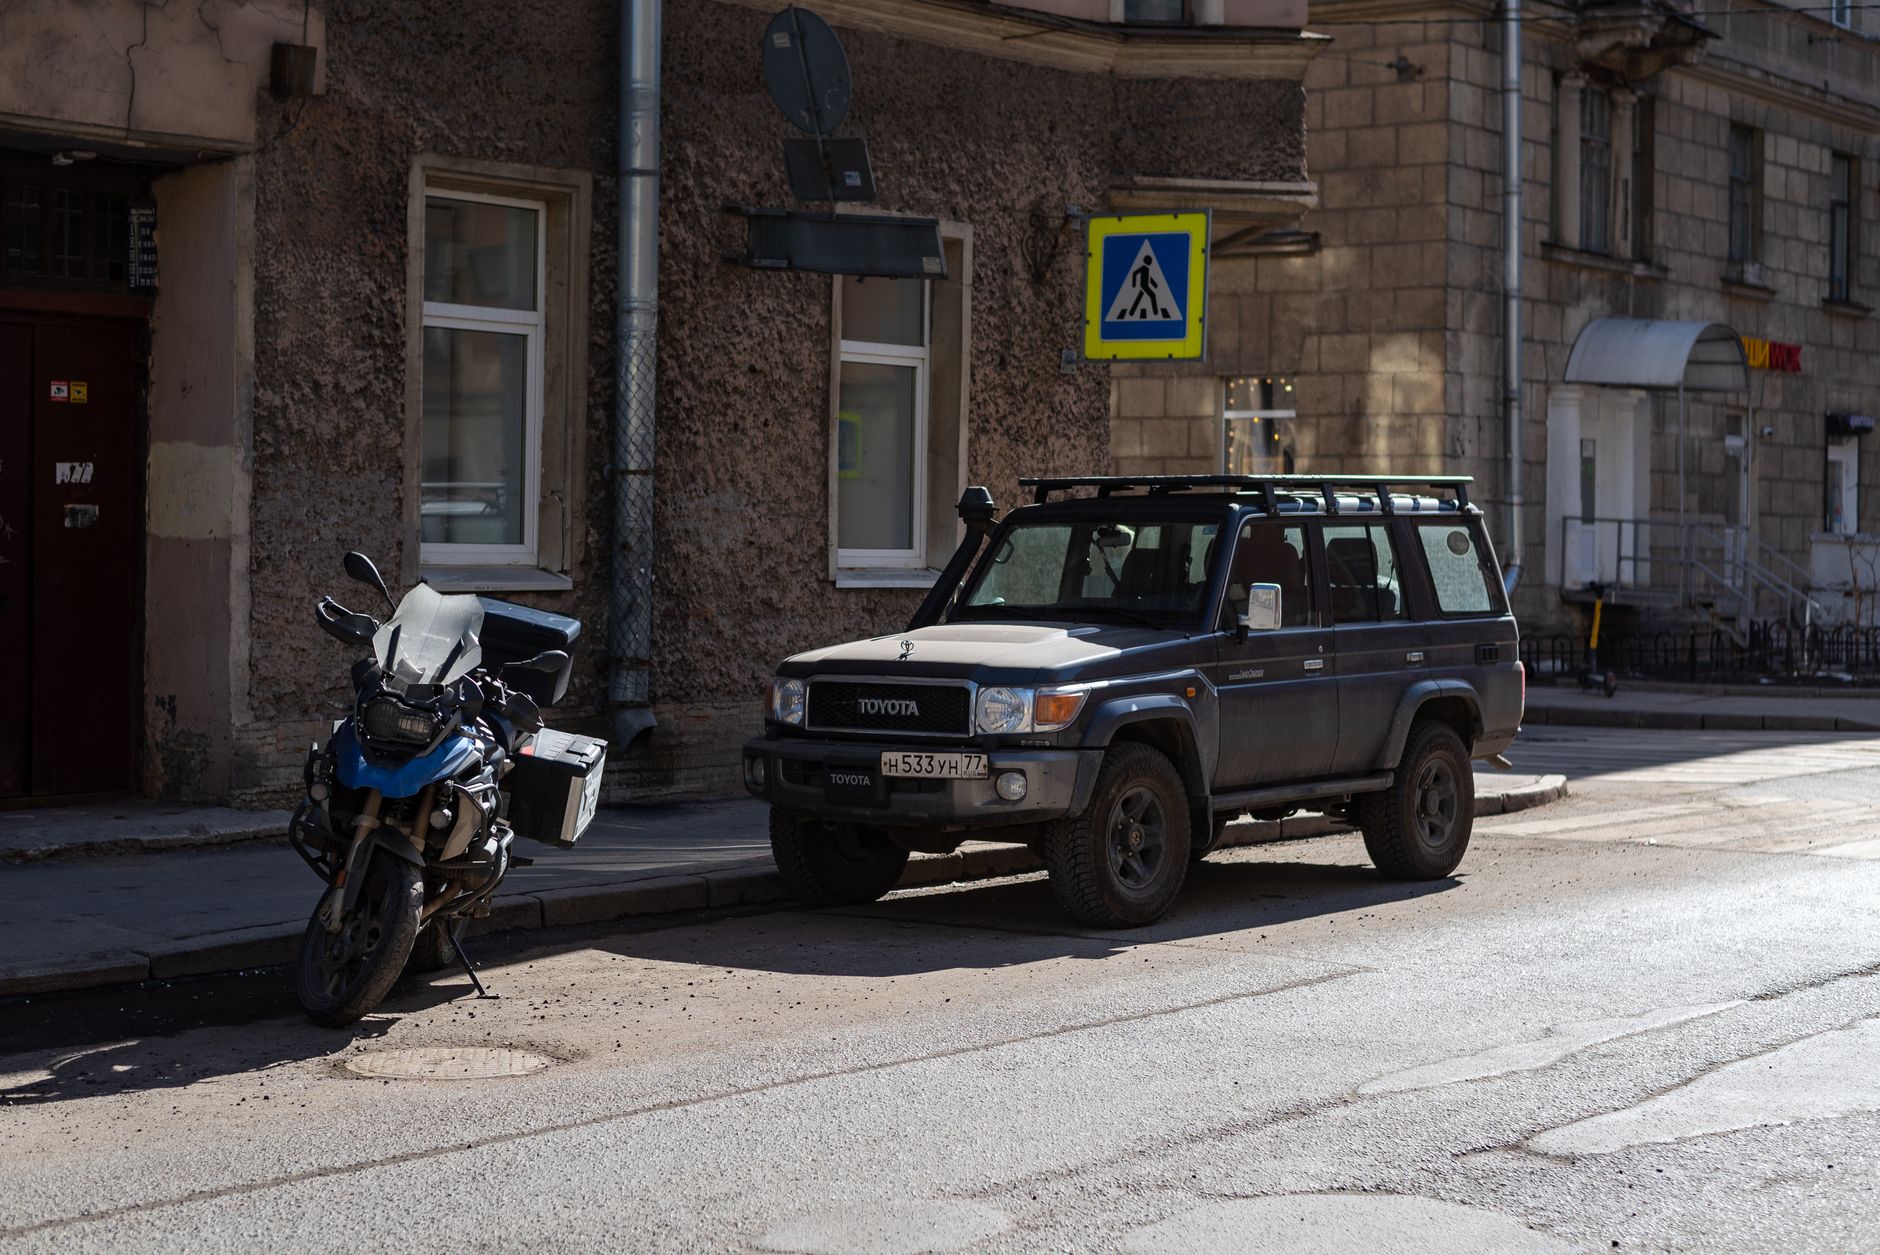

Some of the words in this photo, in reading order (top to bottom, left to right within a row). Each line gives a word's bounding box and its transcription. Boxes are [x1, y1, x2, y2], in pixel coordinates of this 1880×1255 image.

[858, 698, 919, 716] TOYOTA
[964, 755, 982, 771] 77
[830, 773, 871, 786] TOYOTA
